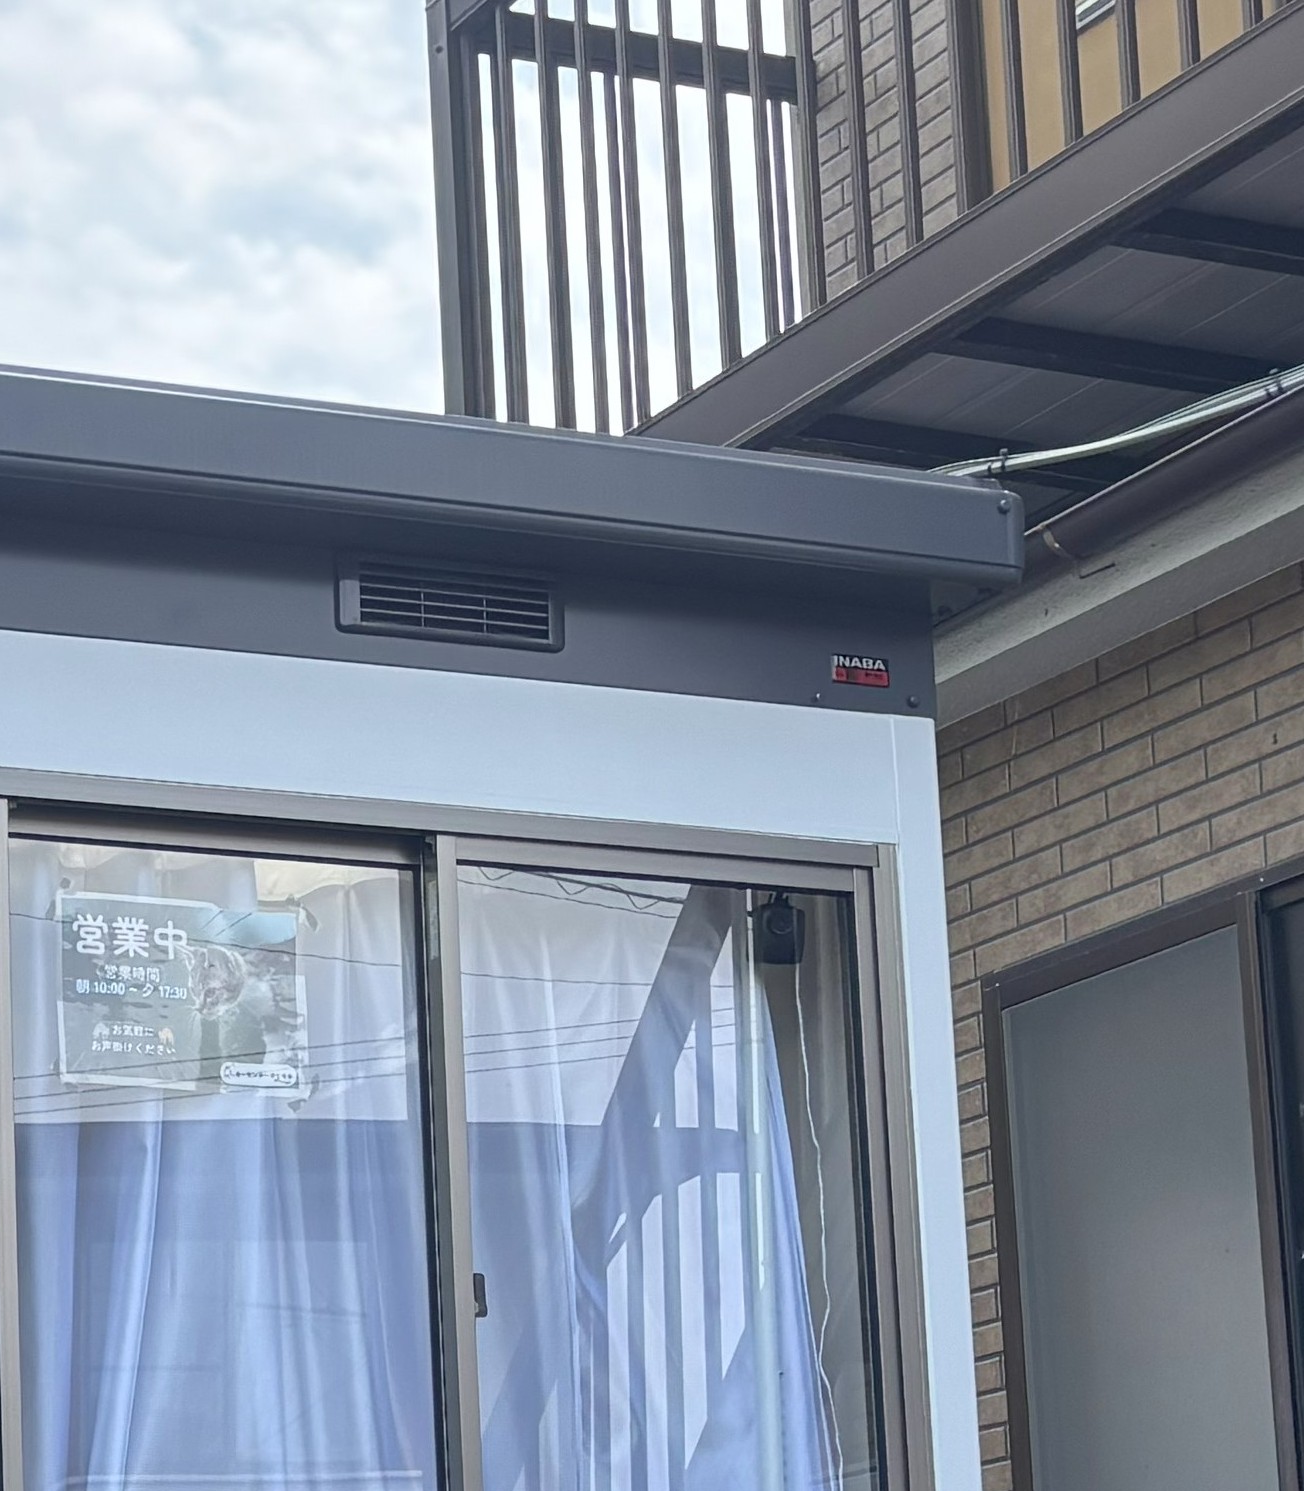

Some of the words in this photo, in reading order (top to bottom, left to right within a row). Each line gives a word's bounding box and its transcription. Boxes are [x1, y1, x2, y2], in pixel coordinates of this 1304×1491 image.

[832, 655, 886, 671] INABA
[72, 913, 189, 960] 営業中
[103, 965, 161, 983] 営業時間
[93, 981, 126, 996] 10:00
[142, 982, 154, 998] 夕
[158, 985, 188, 1000] 17:30
